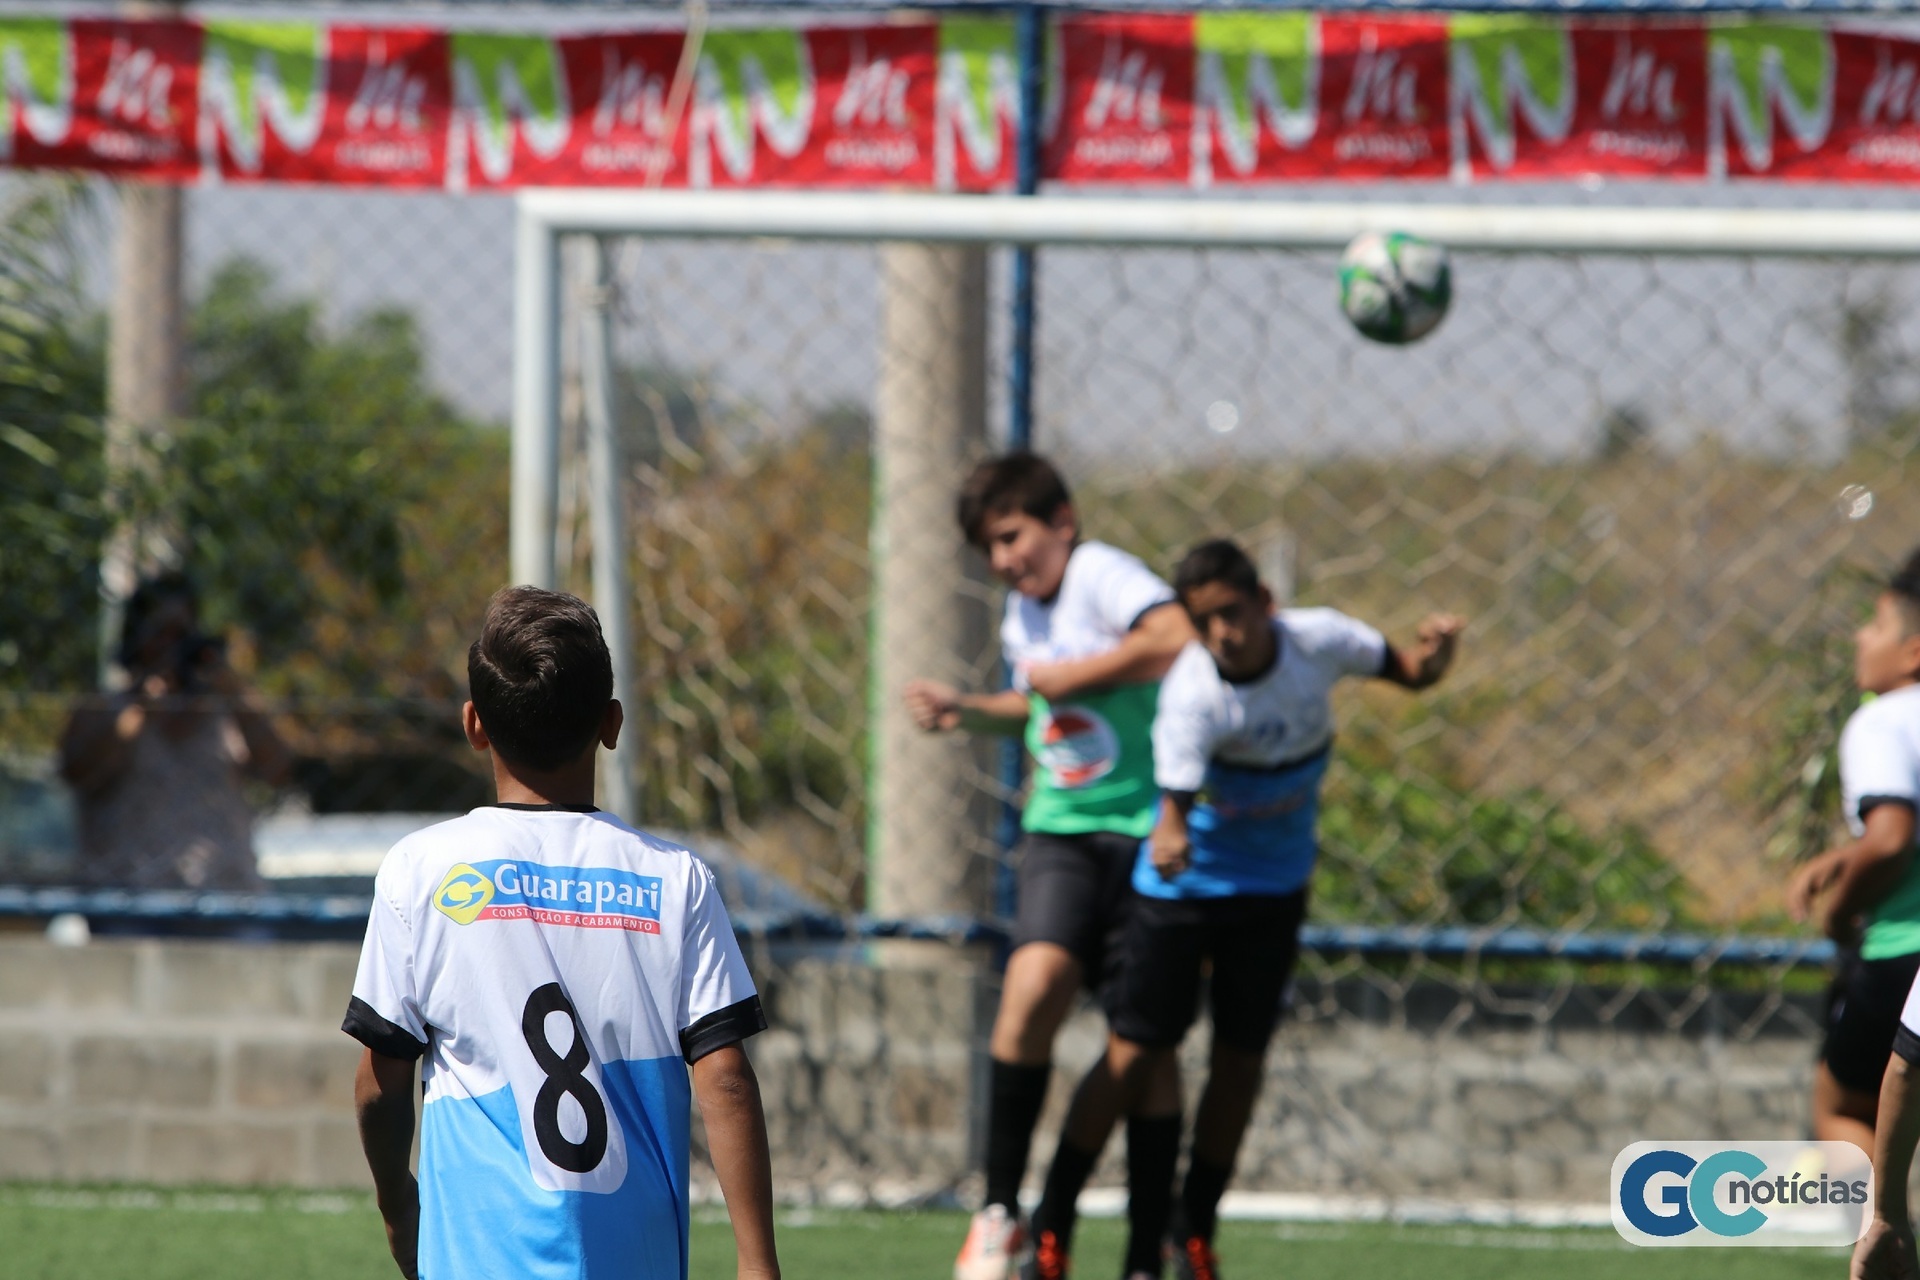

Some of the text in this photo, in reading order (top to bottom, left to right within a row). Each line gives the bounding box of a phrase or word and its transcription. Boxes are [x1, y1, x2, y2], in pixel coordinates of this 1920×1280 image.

[494, 863, 659, 913] Guarapari
[565, 914, 571, 924] E
[574, 916, 652, 931] ACABAMENTO
[522, 982, 608, 1173] 8
